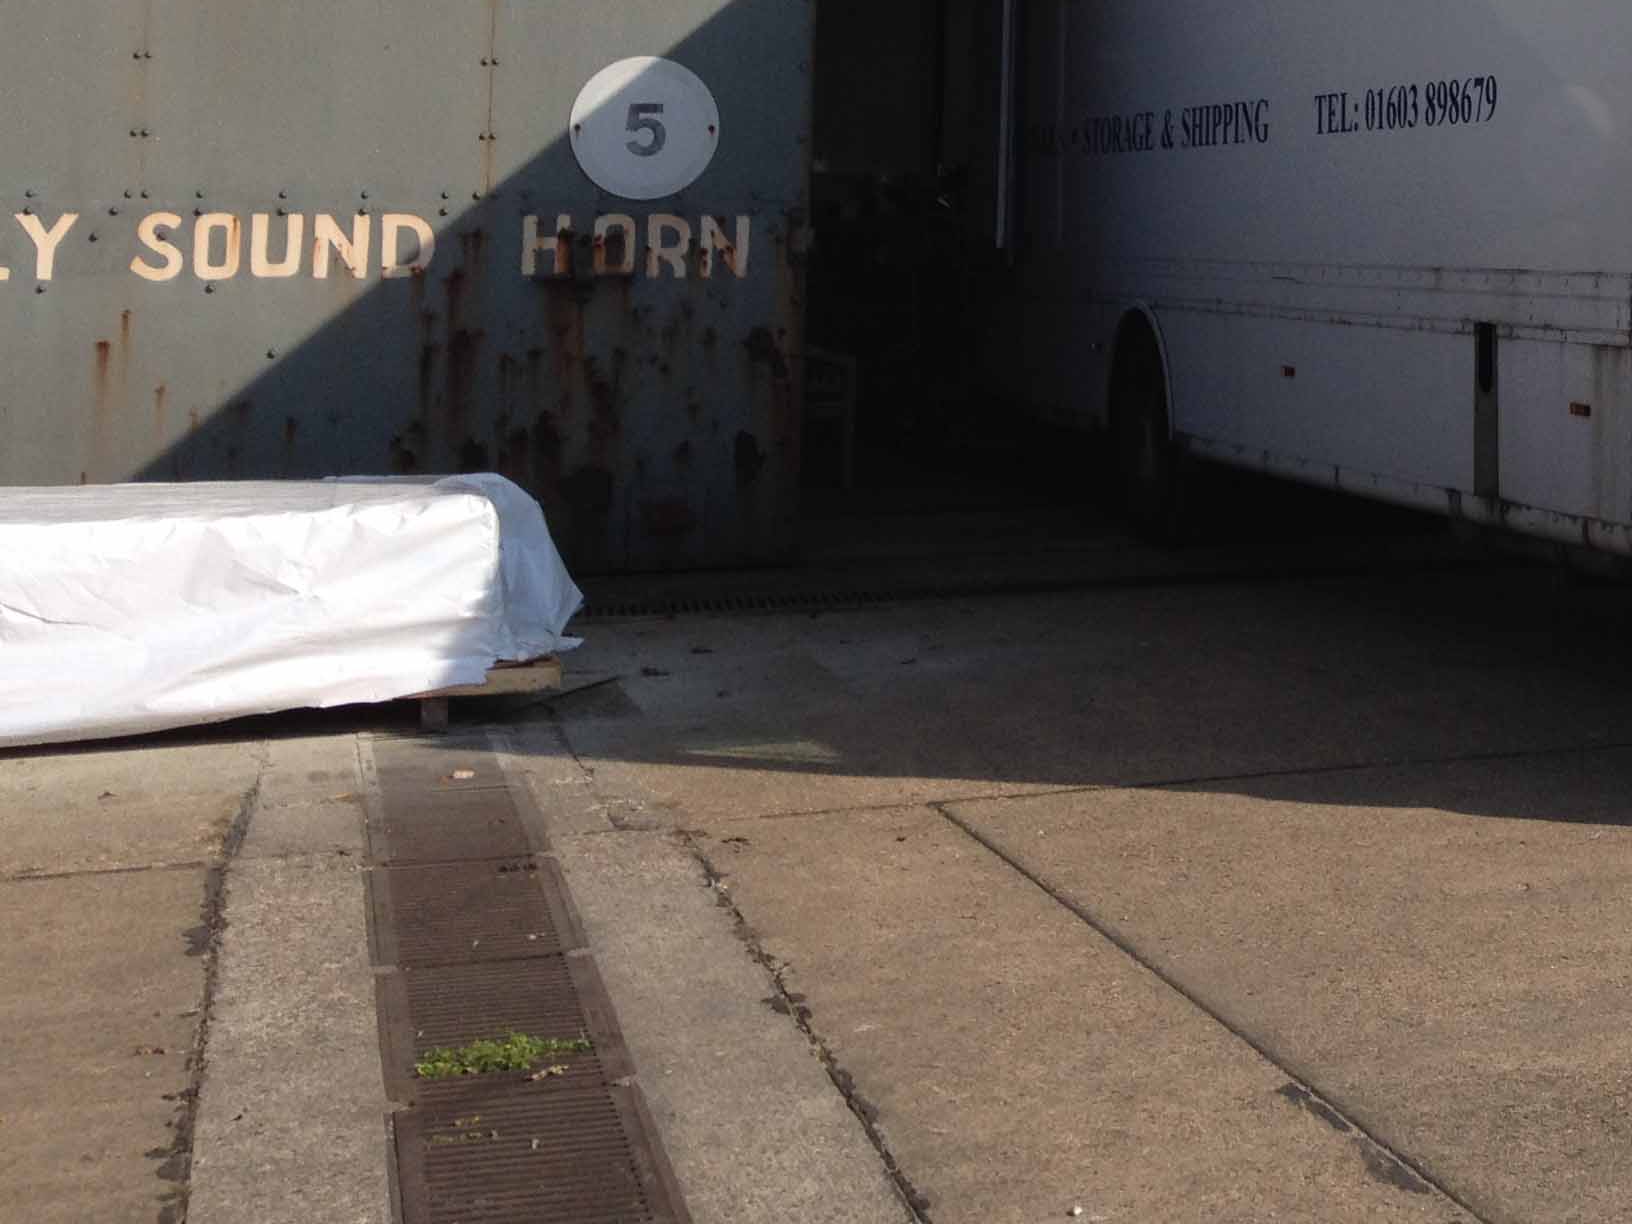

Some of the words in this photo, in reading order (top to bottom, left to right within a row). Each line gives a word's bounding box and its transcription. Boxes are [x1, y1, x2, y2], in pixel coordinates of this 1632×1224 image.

[624, 101, 666, 157] 5
[1084, 112, 1154, 155] STORAGE
[1161, 108, 1174, 149] &
[1181, 99, 1270, 147] SHIPPING
[1315, 92, 1359, 135] TEL:
[1365, 83, 1419, 131] 01603
[1425, 74, 1498, 127] 898679
[0, 212, 79, 280] Y
[130, 212, 436, 281] SOUND
[521, 214, 753, 279] HORN
